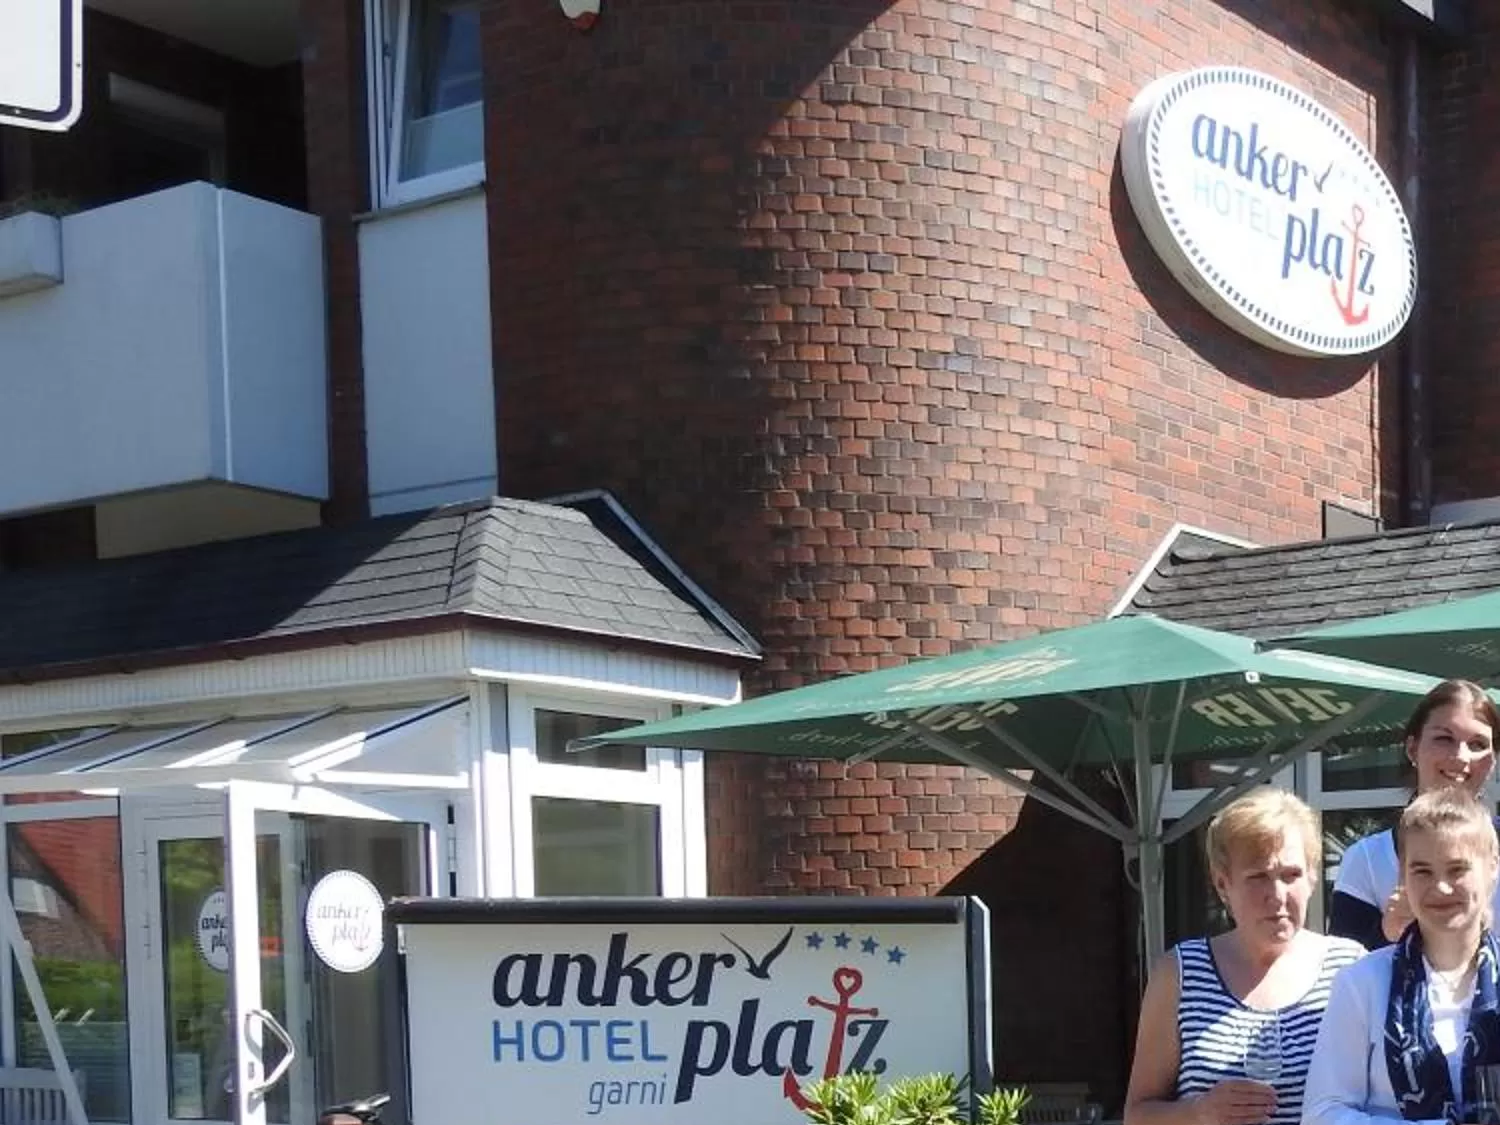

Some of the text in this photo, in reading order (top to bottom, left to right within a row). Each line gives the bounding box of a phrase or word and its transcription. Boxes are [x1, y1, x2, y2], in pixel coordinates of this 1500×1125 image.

[1191, 113, 1308, 202] anker
[1193, 170, 1281, 241] HOTEL
[492, 932, 736, 1008] anker
[493, 1018, 668, 1063] HOTEL
[587, 1073, 668, 1115] garni
